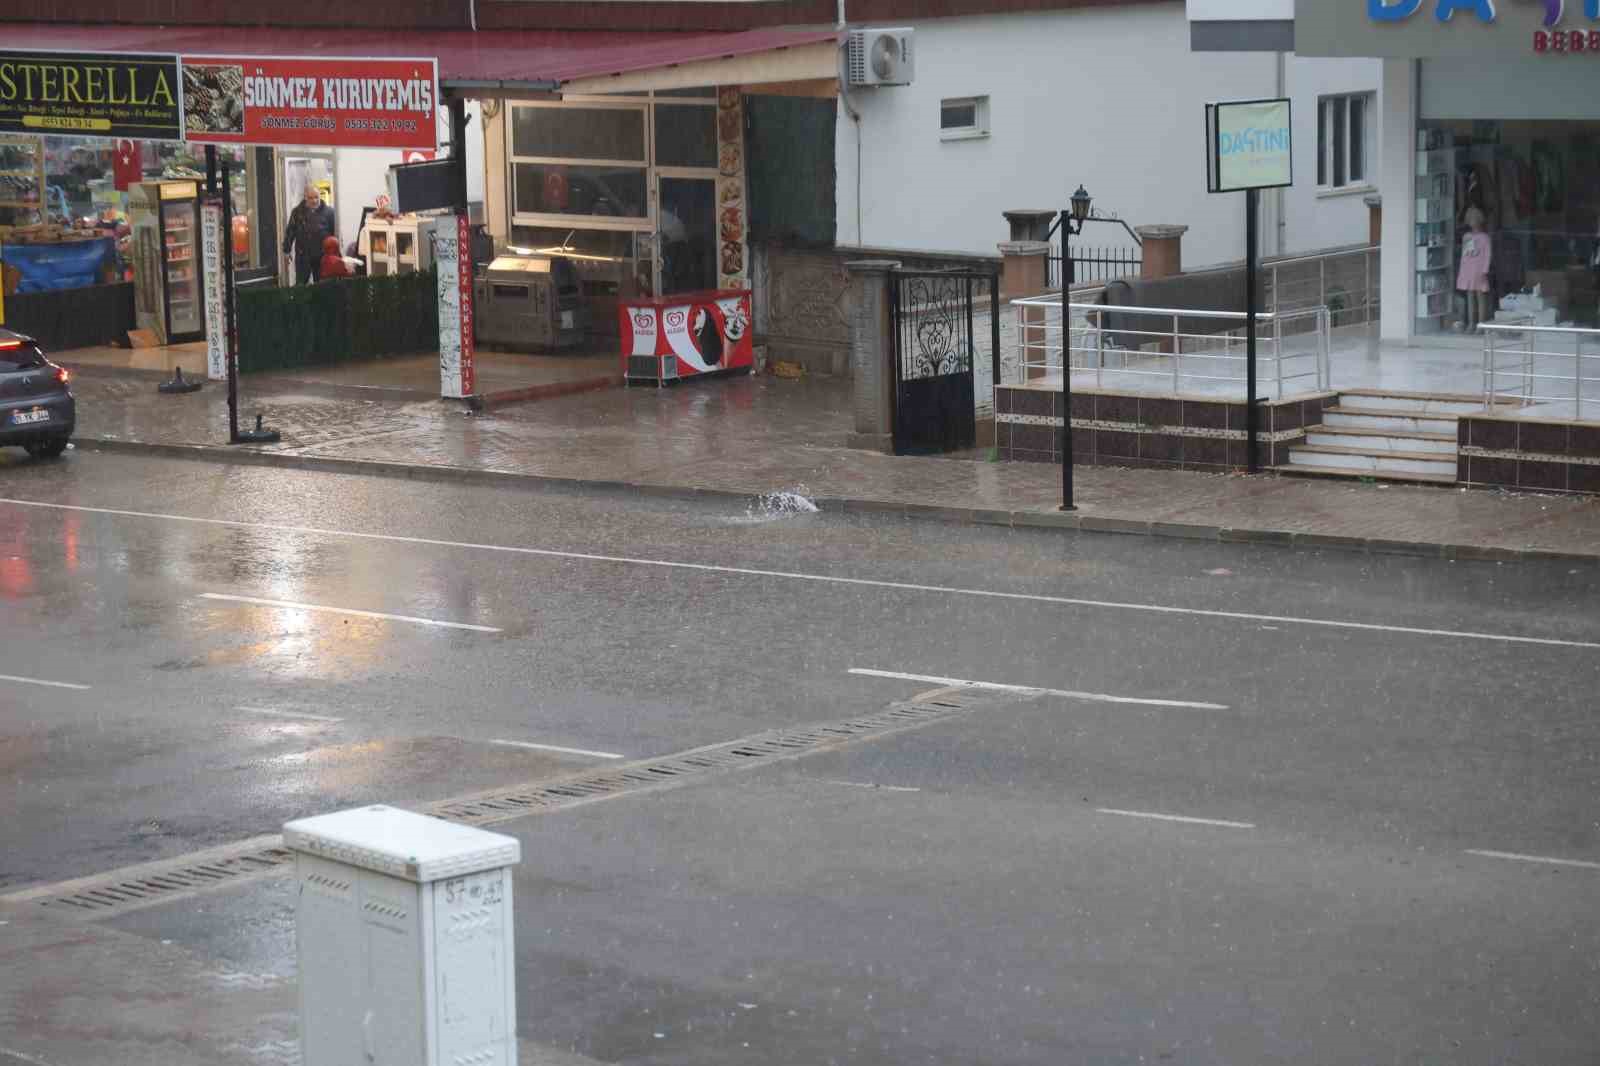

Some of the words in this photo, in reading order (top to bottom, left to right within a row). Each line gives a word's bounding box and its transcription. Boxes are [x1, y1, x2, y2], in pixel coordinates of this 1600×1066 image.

[0, 63, 176, 107] STERELLA
[245, 68, 317, 109] SÖNMEZ
[322, 70, 432, 119] KURUYEMİŞ
